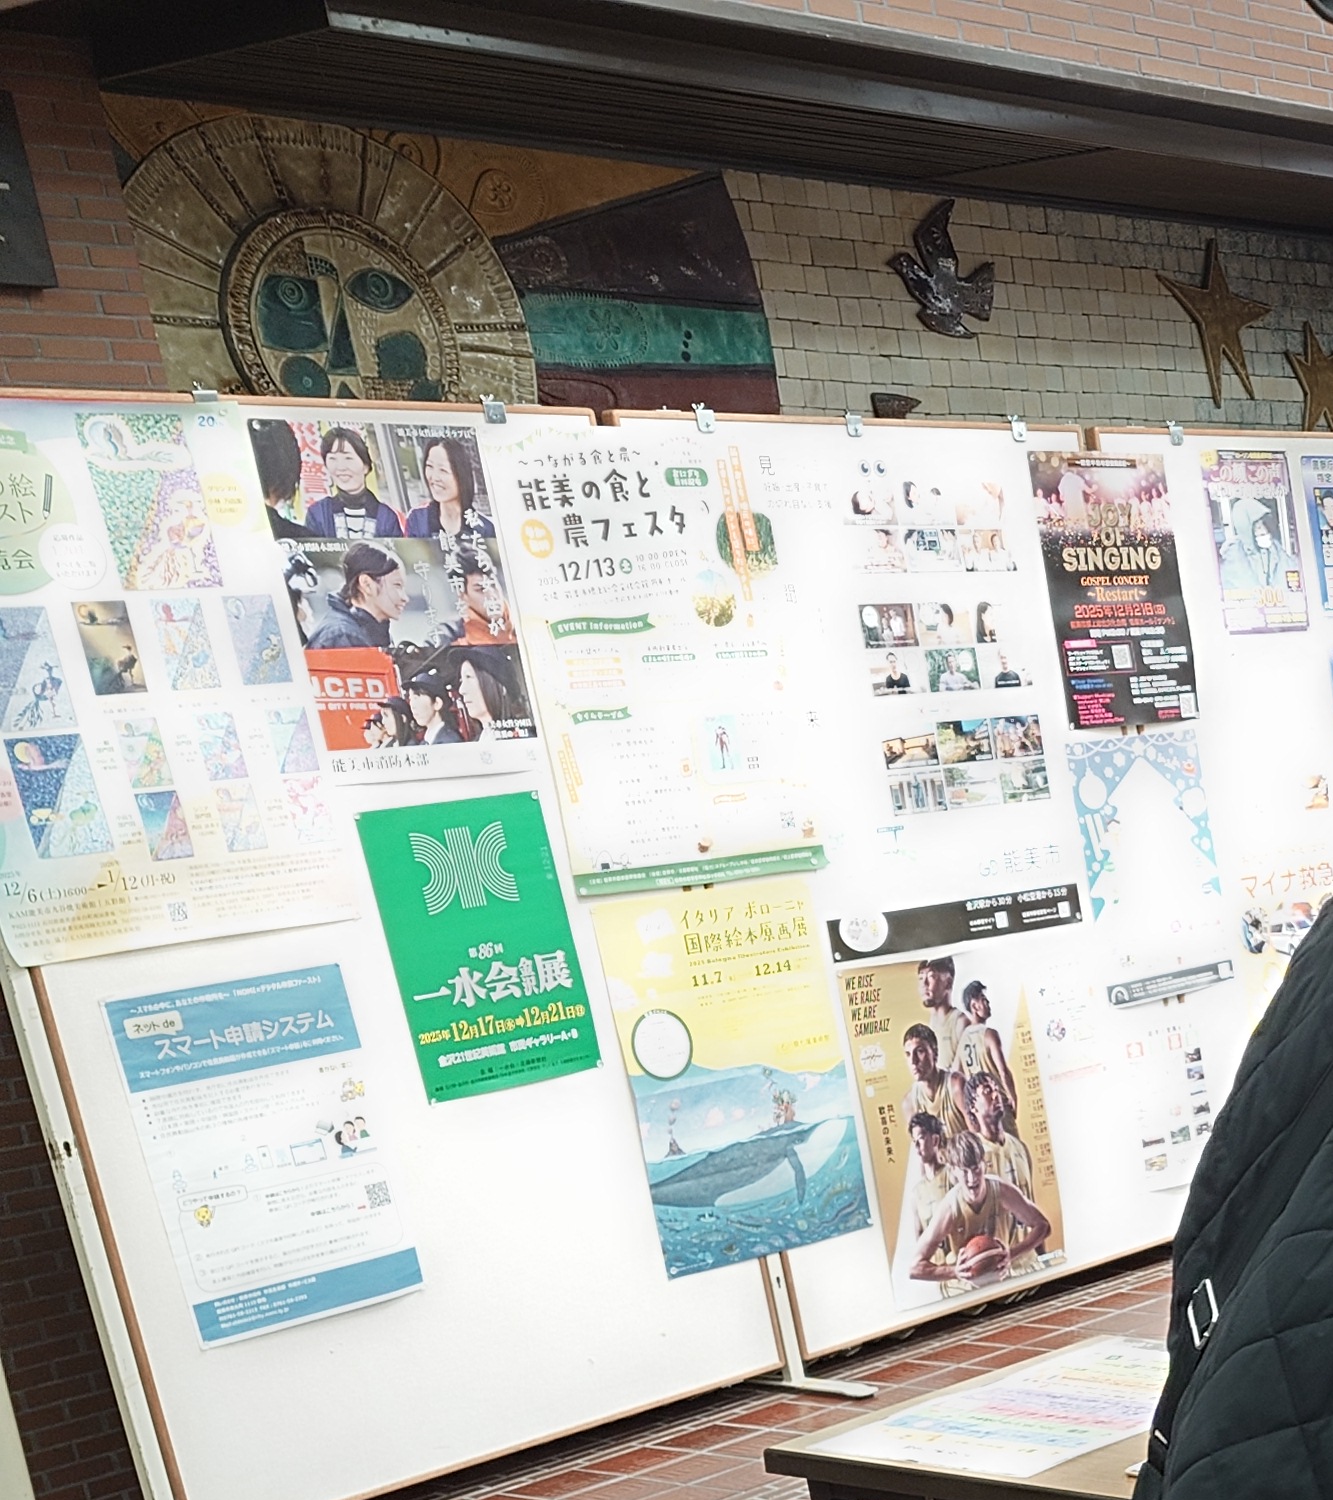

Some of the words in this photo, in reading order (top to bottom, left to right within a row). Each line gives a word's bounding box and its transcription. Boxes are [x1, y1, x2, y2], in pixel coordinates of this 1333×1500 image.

[518, 446, 641, 469] ～つながる食と農～
[518, 468, 652, 511] 能美の食と
[561, 504, 686, 548] 農フェスタ
[1100, 528, 1125, 546] OF
[558, 557, 616, 582] 12/13
[1062, 546, 1162, 572] SINGING
[1080, 576, 1111, 586] GOSPEL
[1113, 574, 1150, 586] CONCERT
[412, 560, 441, 649] 守ります
[1003, 845, 1061, 873] 能美市
[680, 906, 734, 930] イタリア
[744, 900, 804, 919] ボローニャ
[684, 915, 808, 956] 国際絵本原画展
[691, 970, 723, 988] 11.7
[754, 959, 792, 977] 12.14
[845, 976, 856, 991] WE
[857, 973, 875, 989] RISE
[848, 991, 859, 1006] WE
[859, 988, 882, 1004] RAISE
[851, 1007, 862, 1022] WE
[863, 1004, 877, 1020] ARE
[132, 1021, 160, 1034] ネット
[162, 1018, 176, 1030] de
[154, 1009, 334, 1060] スマート申請システム
[853, 1018, 891, 1038] SAMURAIZ
[964, 1044, 980, 1067] 31
